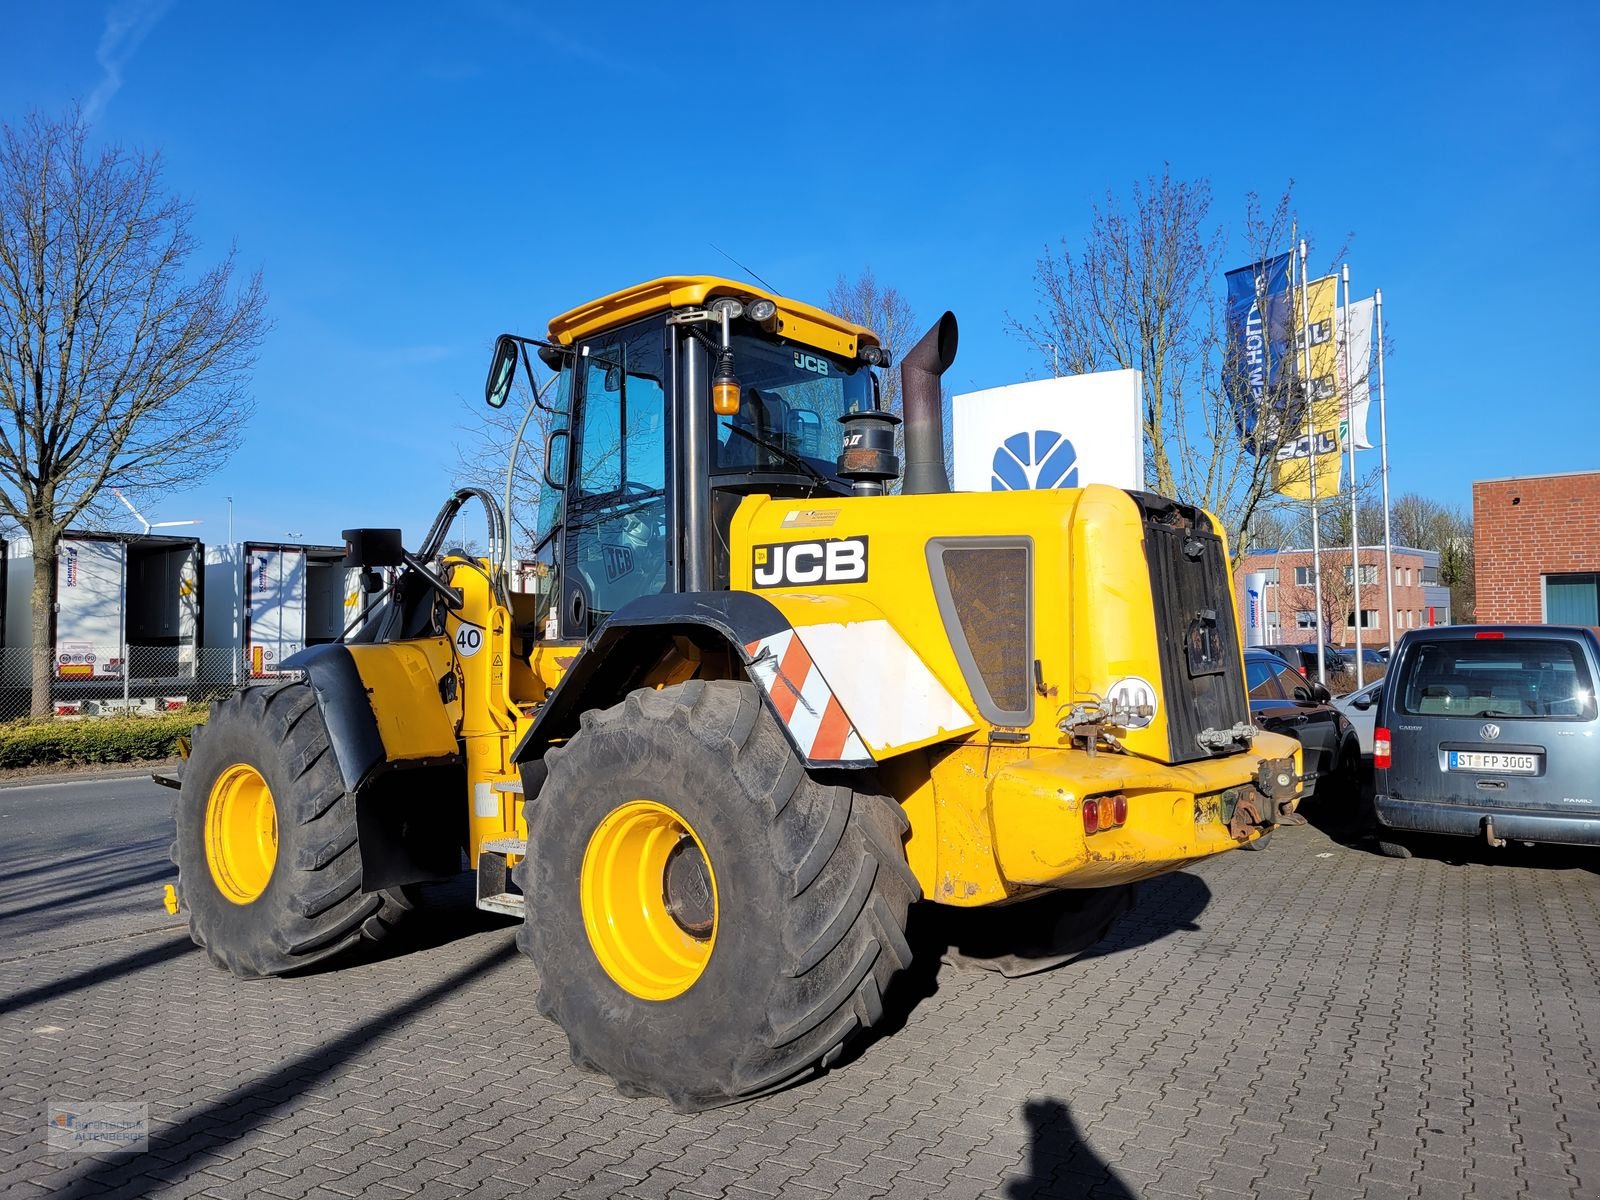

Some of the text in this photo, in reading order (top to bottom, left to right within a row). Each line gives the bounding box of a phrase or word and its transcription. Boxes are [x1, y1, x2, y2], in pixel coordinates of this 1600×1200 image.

[795, 354, 828, 375] JCB
[608, 544, 632, 579] JCB
[755, 540, 865, 585] JCB
[457, 629, 480, 648] 40
[1459, 754, 1473, 766] ST
[1484, 755, 1498, 767] FP
[1502, 756, 1532, 768] 3005
